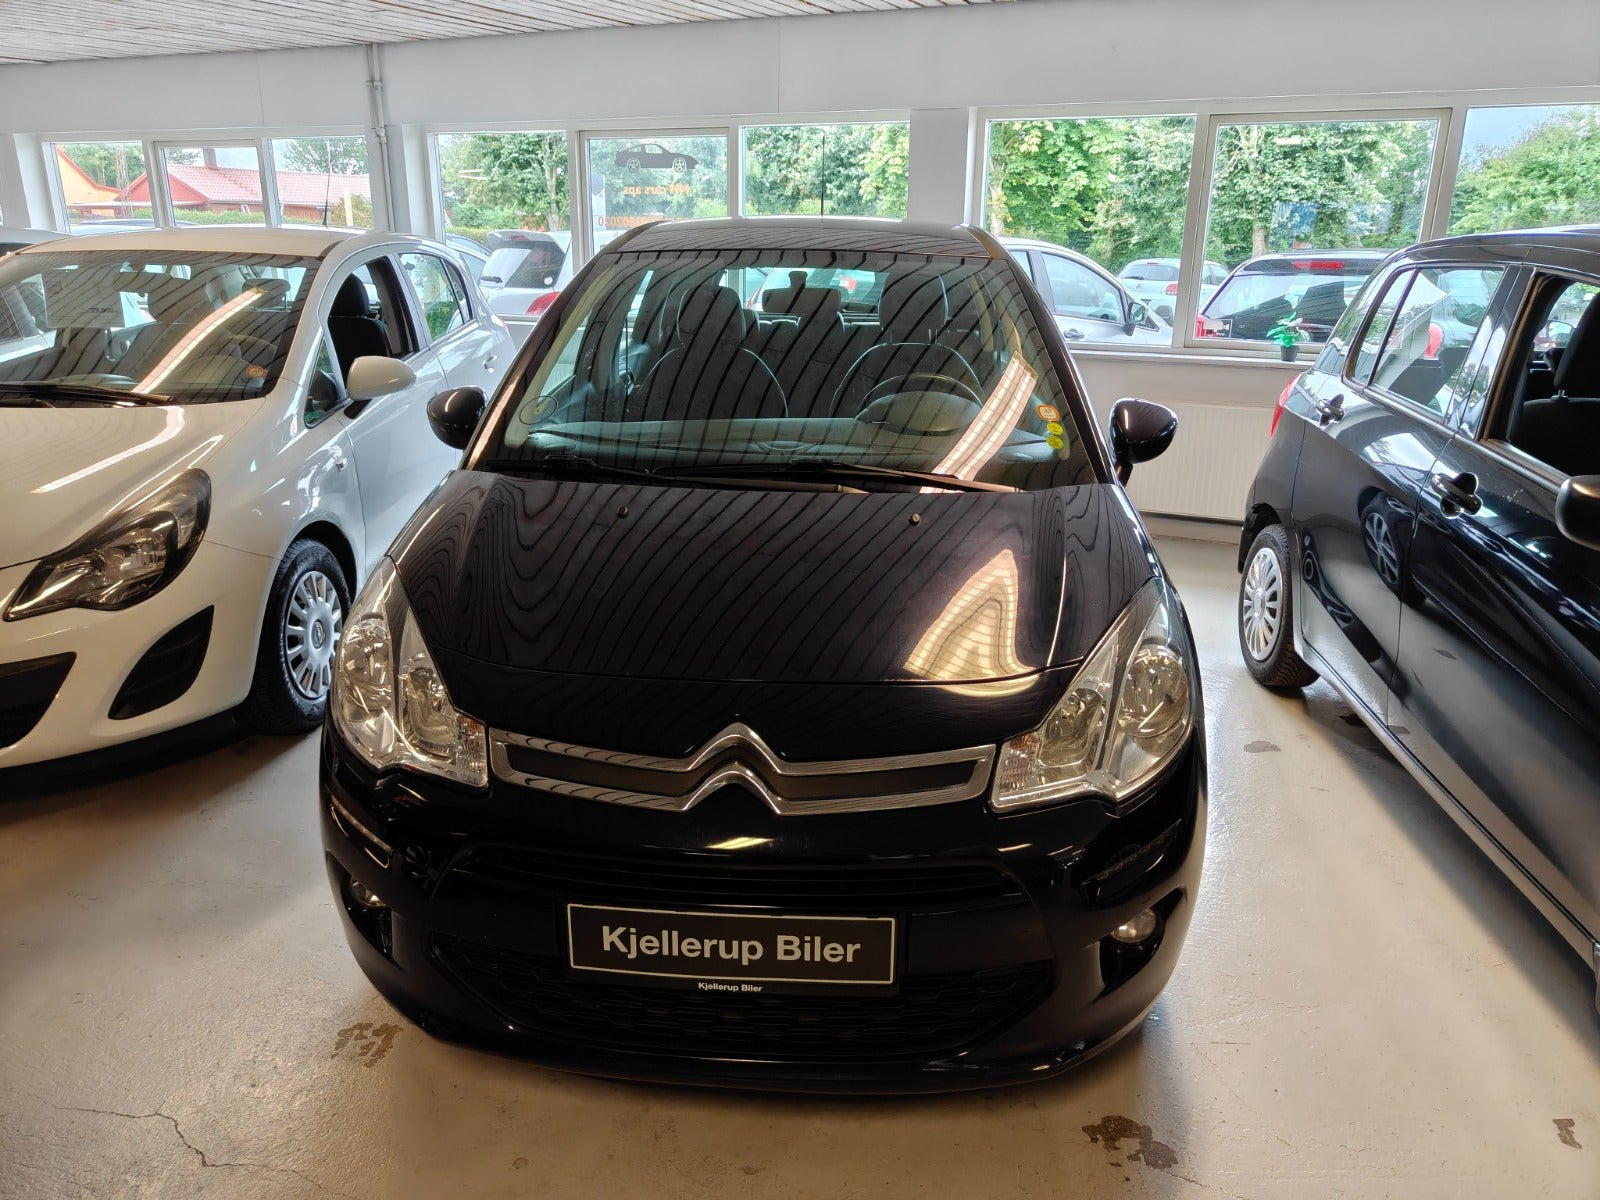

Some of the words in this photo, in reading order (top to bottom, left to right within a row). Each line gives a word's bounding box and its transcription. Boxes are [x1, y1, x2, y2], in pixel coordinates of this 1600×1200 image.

[602, 925, 764, 965] Kjellerup
[776, 934, 861, 963] Biler
[698, 982, 739, 992] Kjellerup
[741, 984, 763, 992] Biler
